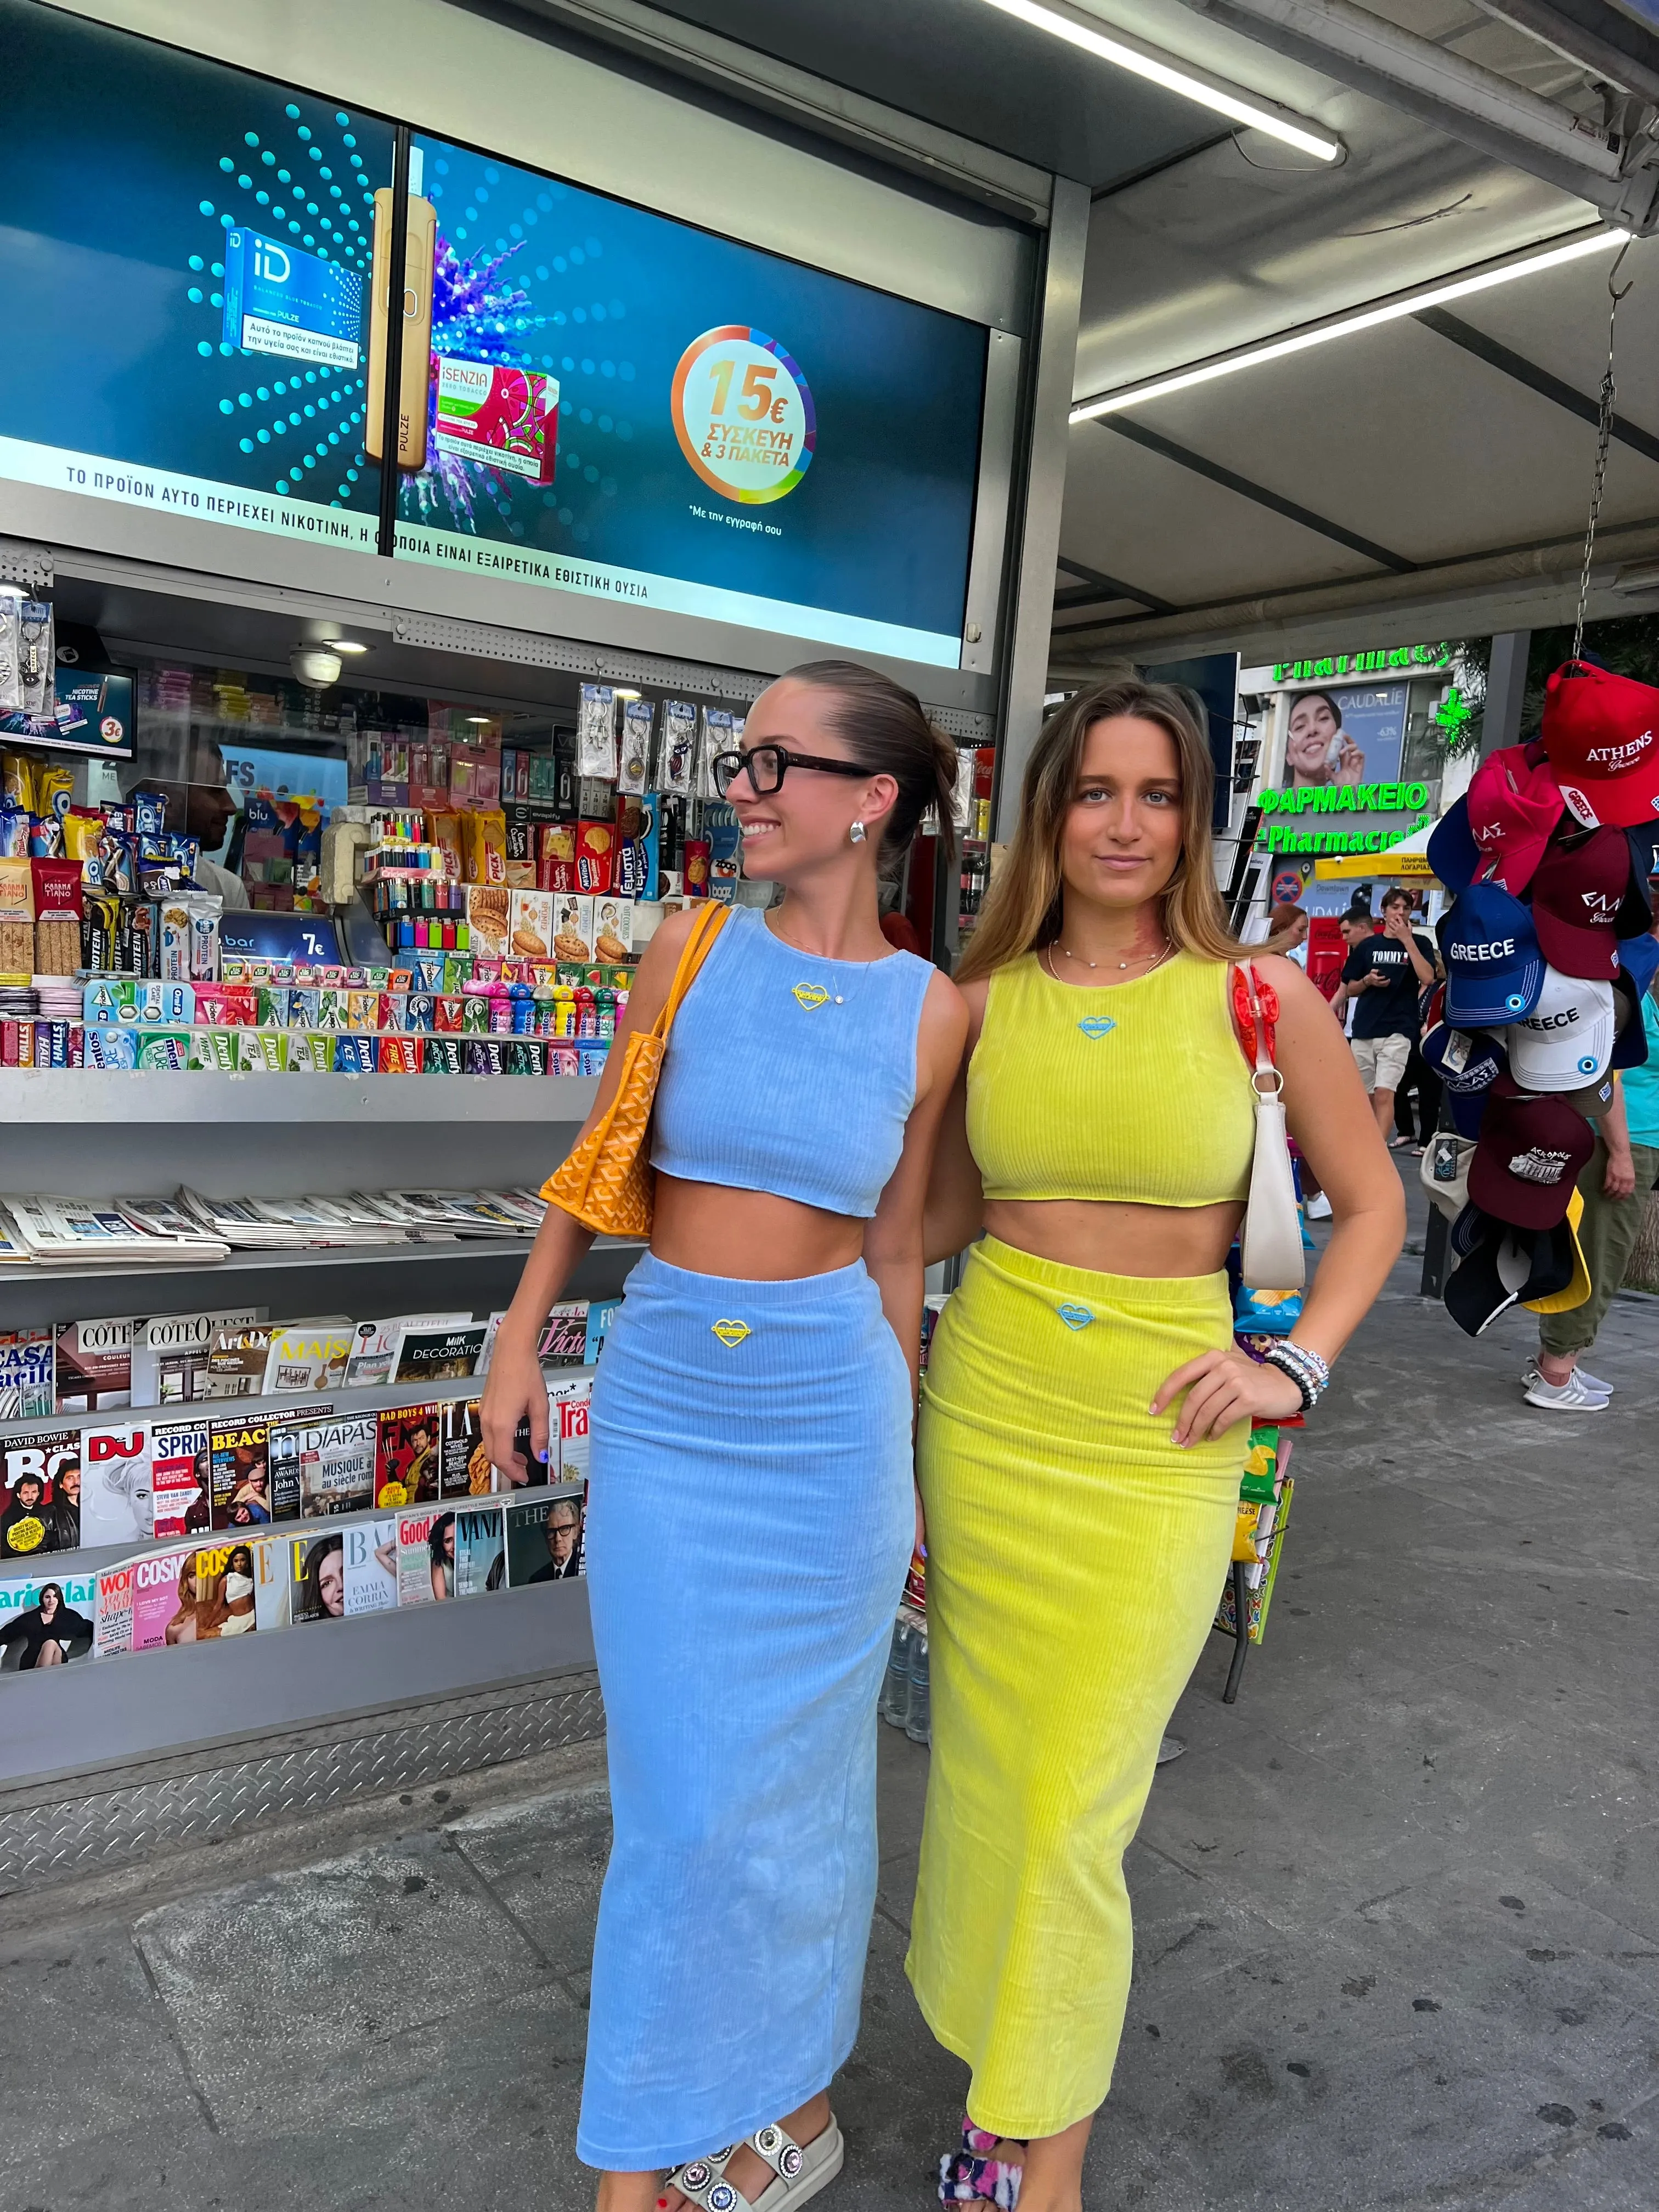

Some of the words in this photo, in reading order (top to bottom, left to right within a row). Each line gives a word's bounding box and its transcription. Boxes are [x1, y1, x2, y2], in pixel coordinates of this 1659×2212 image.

[277, 311, 300, 323] PULZE
[247, 336, 261, 345] την
[264, 339, 284, 349] υγεία
[286, 345, 299, 354] σας
[313, 348, 328, 358] είναι
[250, 323, 270, 334] Αυτό
[283, 331, 306, 342] προϊόν
[308, 337, 331, 348] καπνού
[332, 342, 354, 353] βλάπτει
[459, 385, 487, 396] TOBACCO
[399, 413, 409, 452] PULZE
[707, 423, 793, 451] ΣΥΣΚΕΥΗ
[701, 442, 712, 458] &
[715, 444, 725, 459] 3
[728, 447, 790, 467] ΠΑΚΕΤΑ
[66, 466, 86, 484] ΤΟ
[94, 472, 154, 499] ΠΡΟΪΟΝ
[161, 486, 199, 507] ΑΥΤΟ
[207, 498, 274, 523] ΠΕΡΙΕΧΕΙ
[281, 512, 353, 540] ΝΙΚΟΤΙΝΗ,
[360, 528, 368, 542] Η
[437, 544, 471, 563] ΕΙΝΑΙ
[477, 551, 550, 579] ΕΞΑΙΡΕΤΙΚΑ
[555, 568, 610, 590] ΕΘΙΣΤΙΚΗ
[616, 580, 647, 599] ΟΥΣΙΑ
[708, 510, 724, 522] την
[726, 512, 763, 533] εγγραφή
[765, 524, 782, 535] σου
[104, 721, 120, 737] 3€
[1586, 730, 1653, 761] ATHENS
[1257, 782, 1429, 815] ΦΑΡΜΑΚΕΙΟ
[1568, 790, 1593, 820] GREECE
[249, 809, 268, 821] blu
[533, 812, 560, 820] evapify
[1268, 825, 1404, 853] Pharmacie
[445, 852, 455, 876] PICK
[225, 935, 255, 947] bar
[302, 933, 325, 955] 7€
[1450, 939, 1515, 961] GREECE
[1373, 951, 1402, 963] TOMMY
[174, 990, 182, 1014] Oral-B
[1519, 1007, 1579, 1031] REECE
[19, 1024, 30, 1062] HALLS
[53, 1023, 63, 1062] HALLS
[199, 1037, 211, 1063] WHITE
[246, 1043, 255, 1058] TEA
[297, 1046, 305, 1060] TEA
[343, 1044, 355, 1062] ICE
[388, 1043, 400, 1064] FIRE
[145, 1048, 155, 1063] FRESH
[431, 1041, 441, 1068] ARCTIC
[473, 1042, 484, 1070] ARCTIC
[516, 1044, 526, 1071] ARCTIC
[82, 1324, 132, 1348] CÔTÉ
[150, 1319, 195, 1345] CÔTÉ
[212, 1418, 246, 1429] RECORD
[248, 1411, 296, 1423] COLLECTOR
[297, 1406, 332, 1416] PRESENTS
[381, 1411, 396, 1422] BAD
[397, 1408, 417, 1419] BOYS
[4, 1436, 35, 1448] DAVID
[37, 1432, 69, 1443] BOWIE
[155, 1425, 192, 1435] RECORD
[52, 1442, 80, 1453] CLAS
[323, 1457, 364, 1478] MUSIQUE
[366, 1458, 372, 1469] à
[446, 1455, 467, 1463] NEXT-GEN
[275, 1478, 294, 1492] John
[322, 1480, 331, 1489] au
[334, 1474, 356, 1487] siècle
[456, 1503, 478, 1511] LIFESTYLE
[478, 1499, 501, 1508] MAGAZINE
[510, 1506, 549, 1528] THE
[400, 1517, 430, 1546] Good
[258, 1543, 274, 1586] E
[293, 1540, 309, 1582] E
[348, 1590, 388, 1607] CORRIN
[352, 1581, 386, 1595] EMMA
[353, 1603, 378, 1613] WRITING
[144, 1635, 163, 1644] MODA
